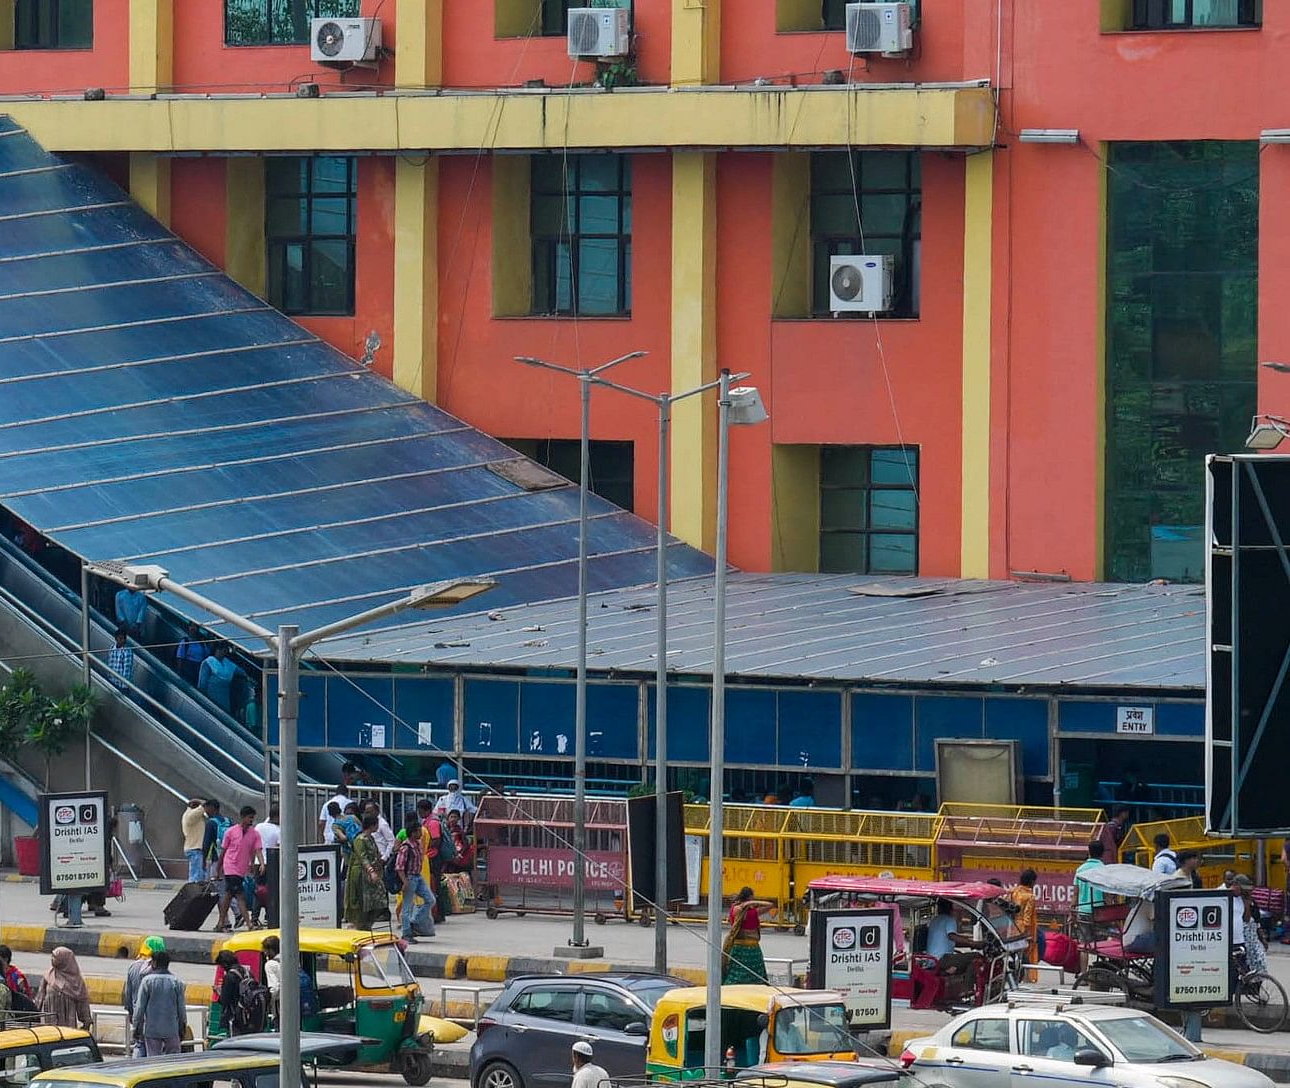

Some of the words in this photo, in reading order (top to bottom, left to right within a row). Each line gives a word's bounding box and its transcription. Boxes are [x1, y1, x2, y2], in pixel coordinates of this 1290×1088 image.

[1122, 722, 1147, 731] ENTRY
[54, 828, 81, 837] Drishti
[84, 826, 98, 835] IAS
[512, 857, 553, 876] DELHI
[558, 858, 607, 878] POICE
[298, 883, 314, 893] shti
[316, 882, 330, 892] IAS
[1033, 884, 1074, 902] OLICE
[1175, 932, 1204, 942] Drishti
[1206, 931, 1222, 941] IAS
[831, 953, 862, 964] Drishti
[864, 952, 881, 961] IAS
